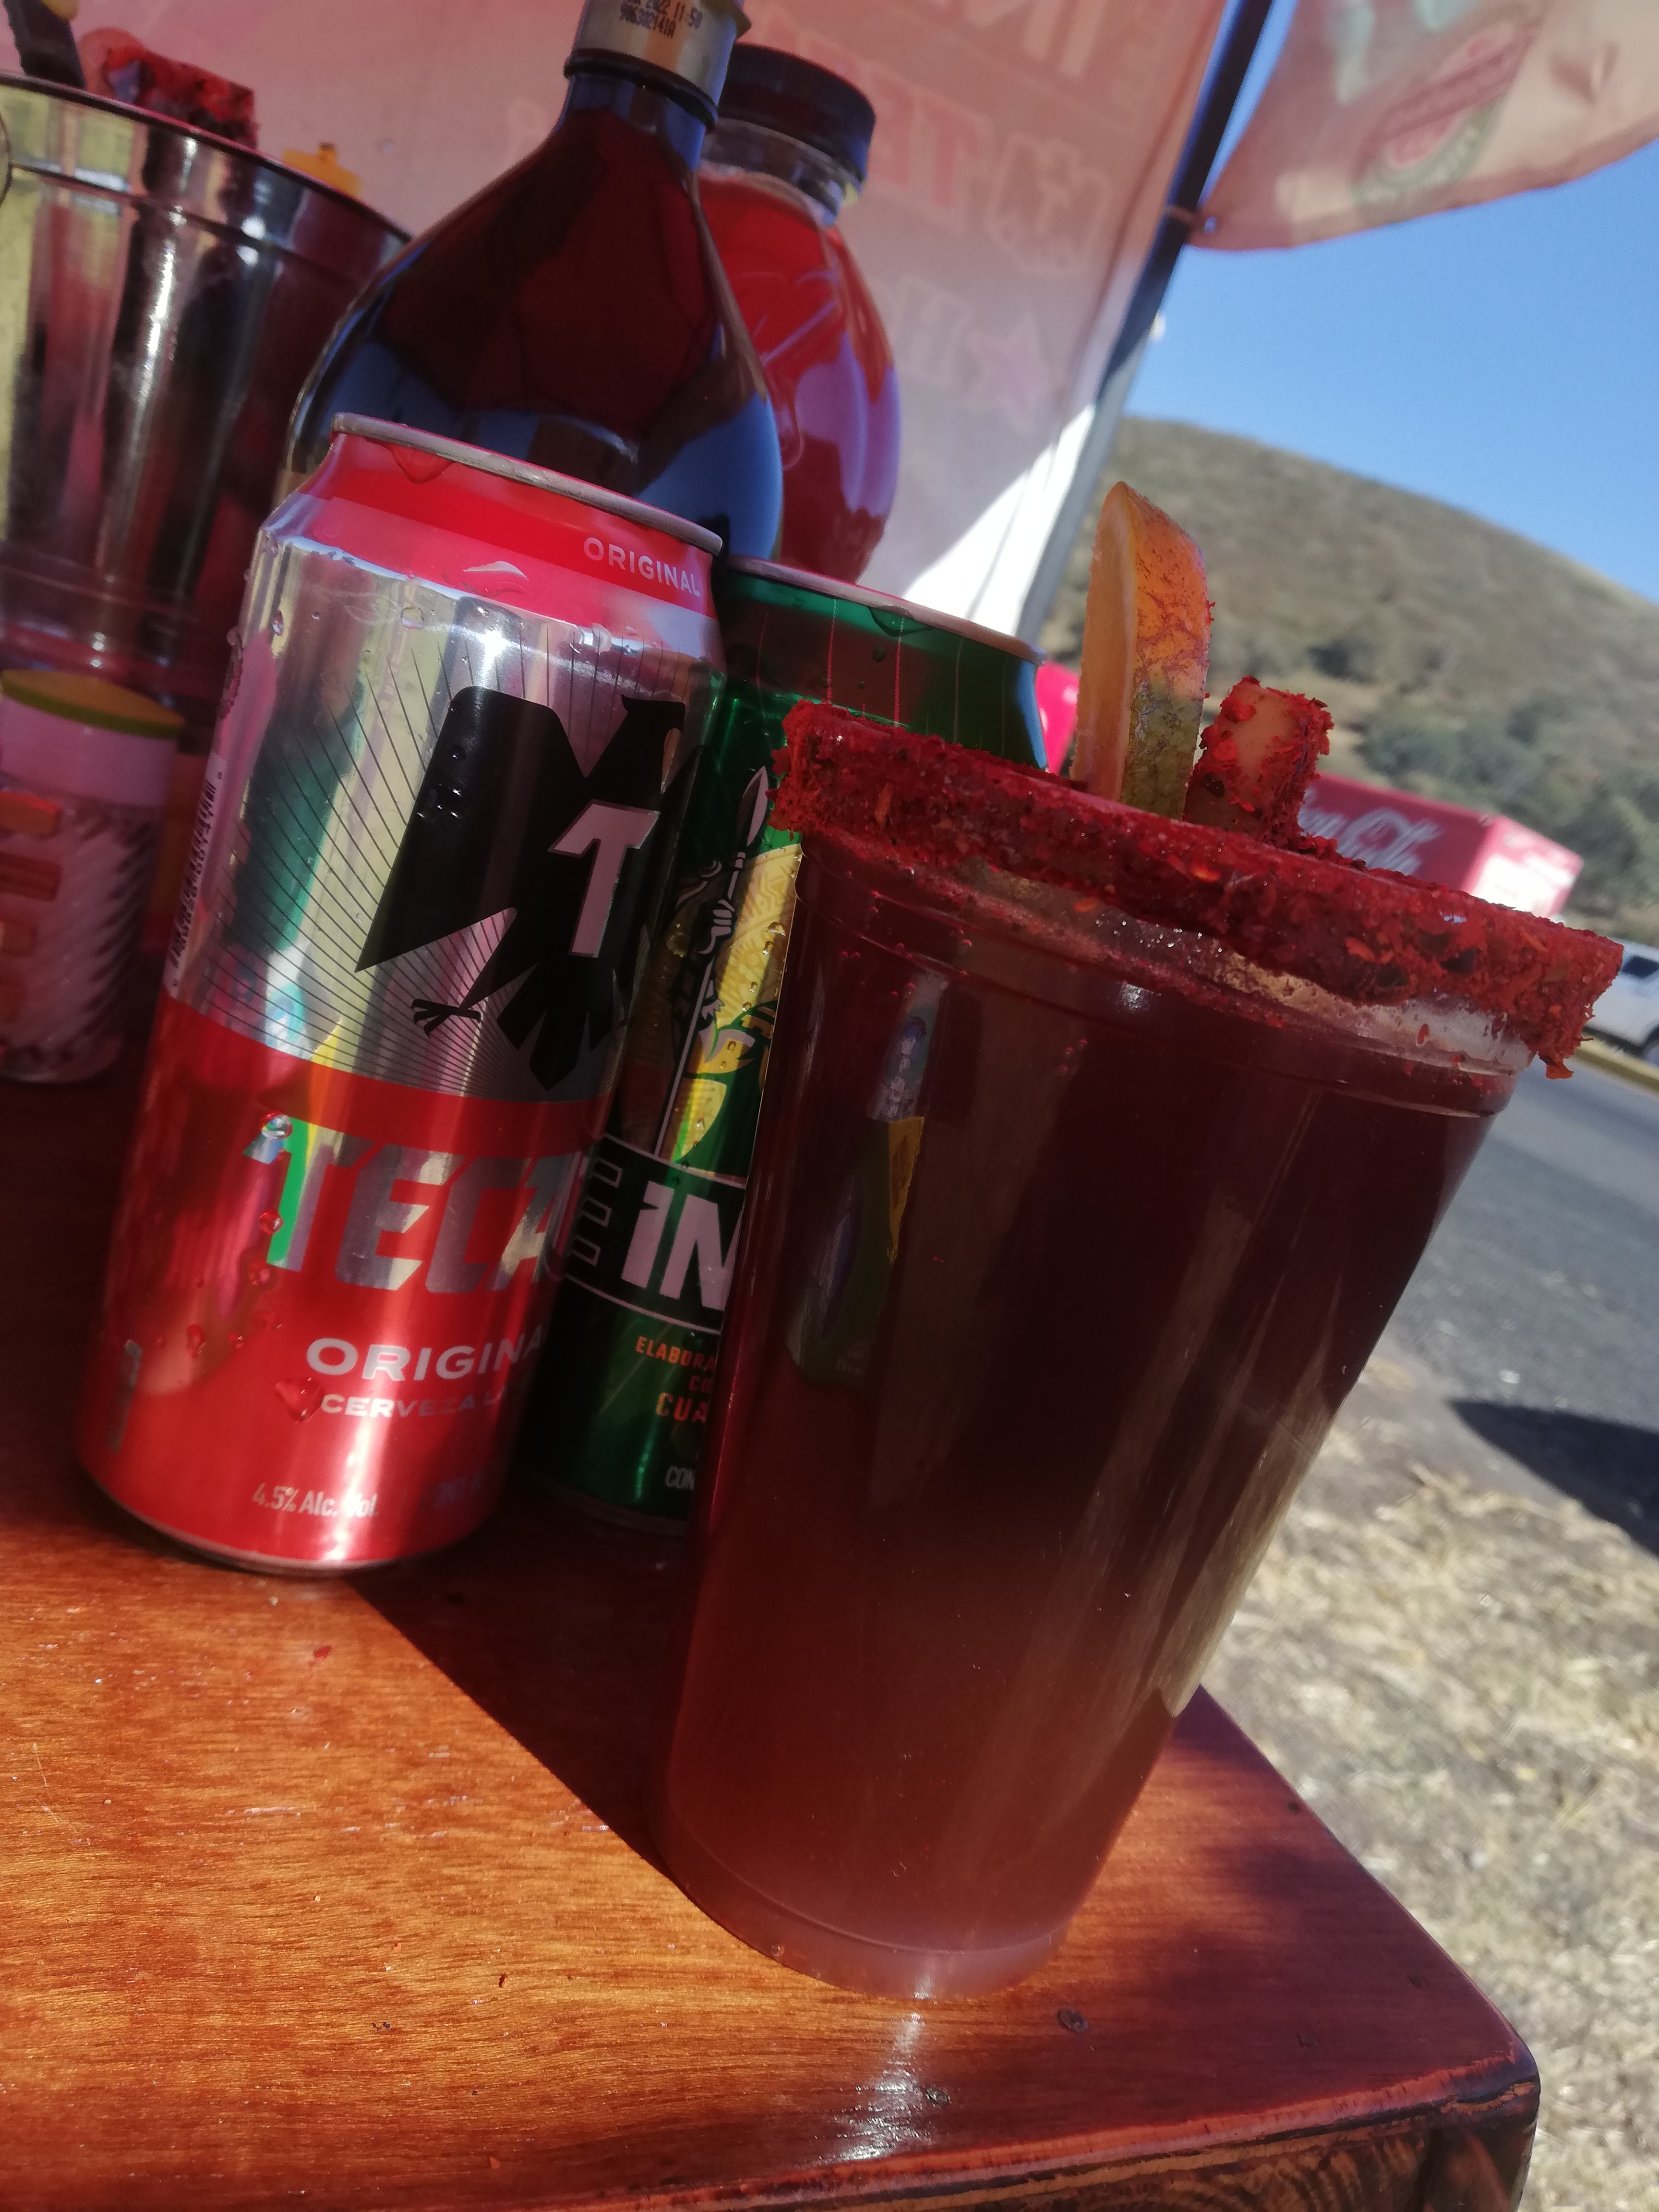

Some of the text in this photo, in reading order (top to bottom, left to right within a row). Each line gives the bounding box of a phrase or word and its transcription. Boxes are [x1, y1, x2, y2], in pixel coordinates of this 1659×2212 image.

[583, 537, 700, 597] ORIGINAL
[321, 1393, 475, 1419] CERVEZA
[298, 1490, 338, 1517] Alc.
